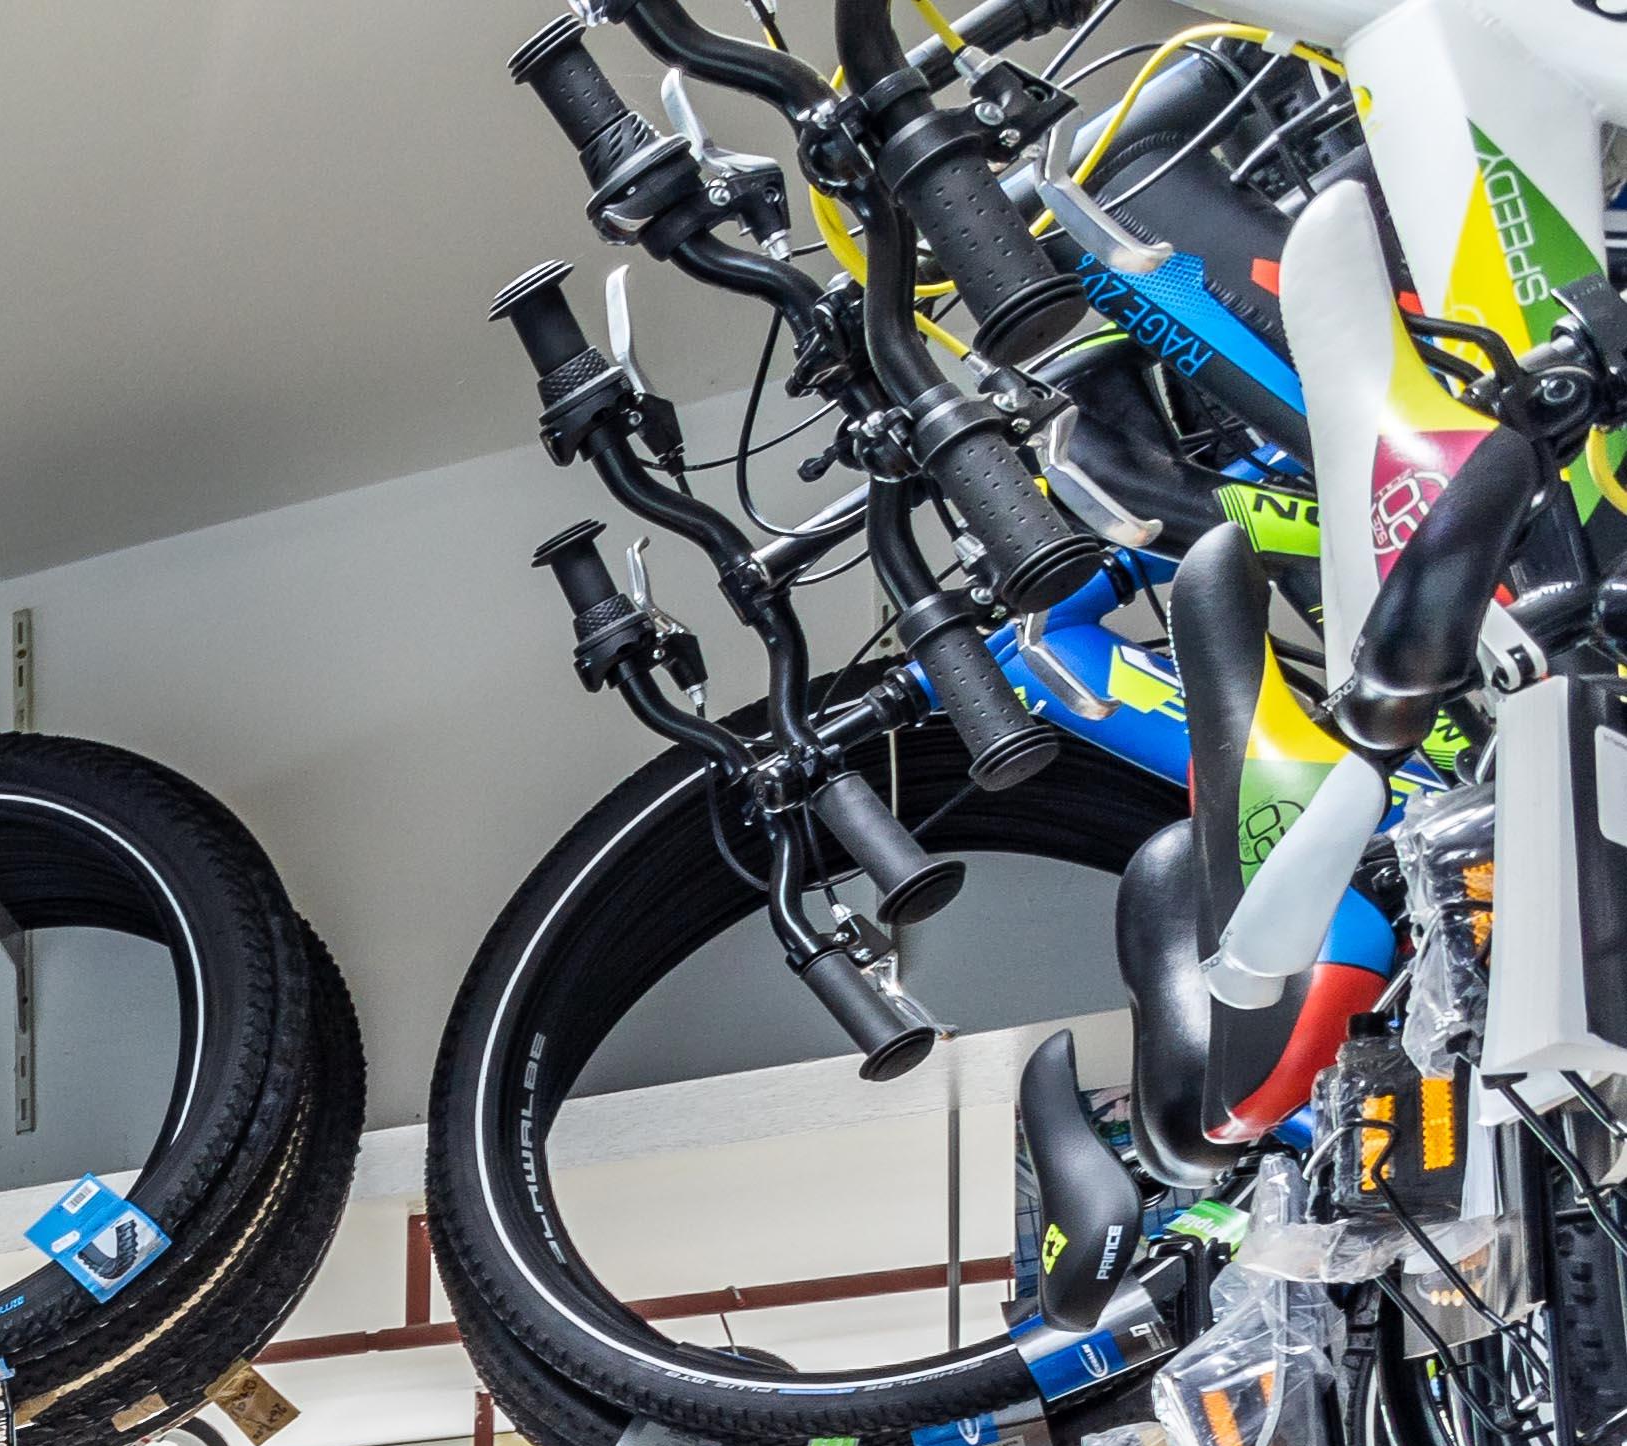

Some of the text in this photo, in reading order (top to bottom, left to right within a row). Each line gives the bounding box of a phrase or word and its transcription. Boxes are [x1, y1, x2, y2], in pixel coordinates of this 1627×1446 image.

[1475, 150, 1551, 304] SPEEDY
[1136, 303, 1215, 379] RAGE
[1096, 1224, 1124, 1281] PRINCE
